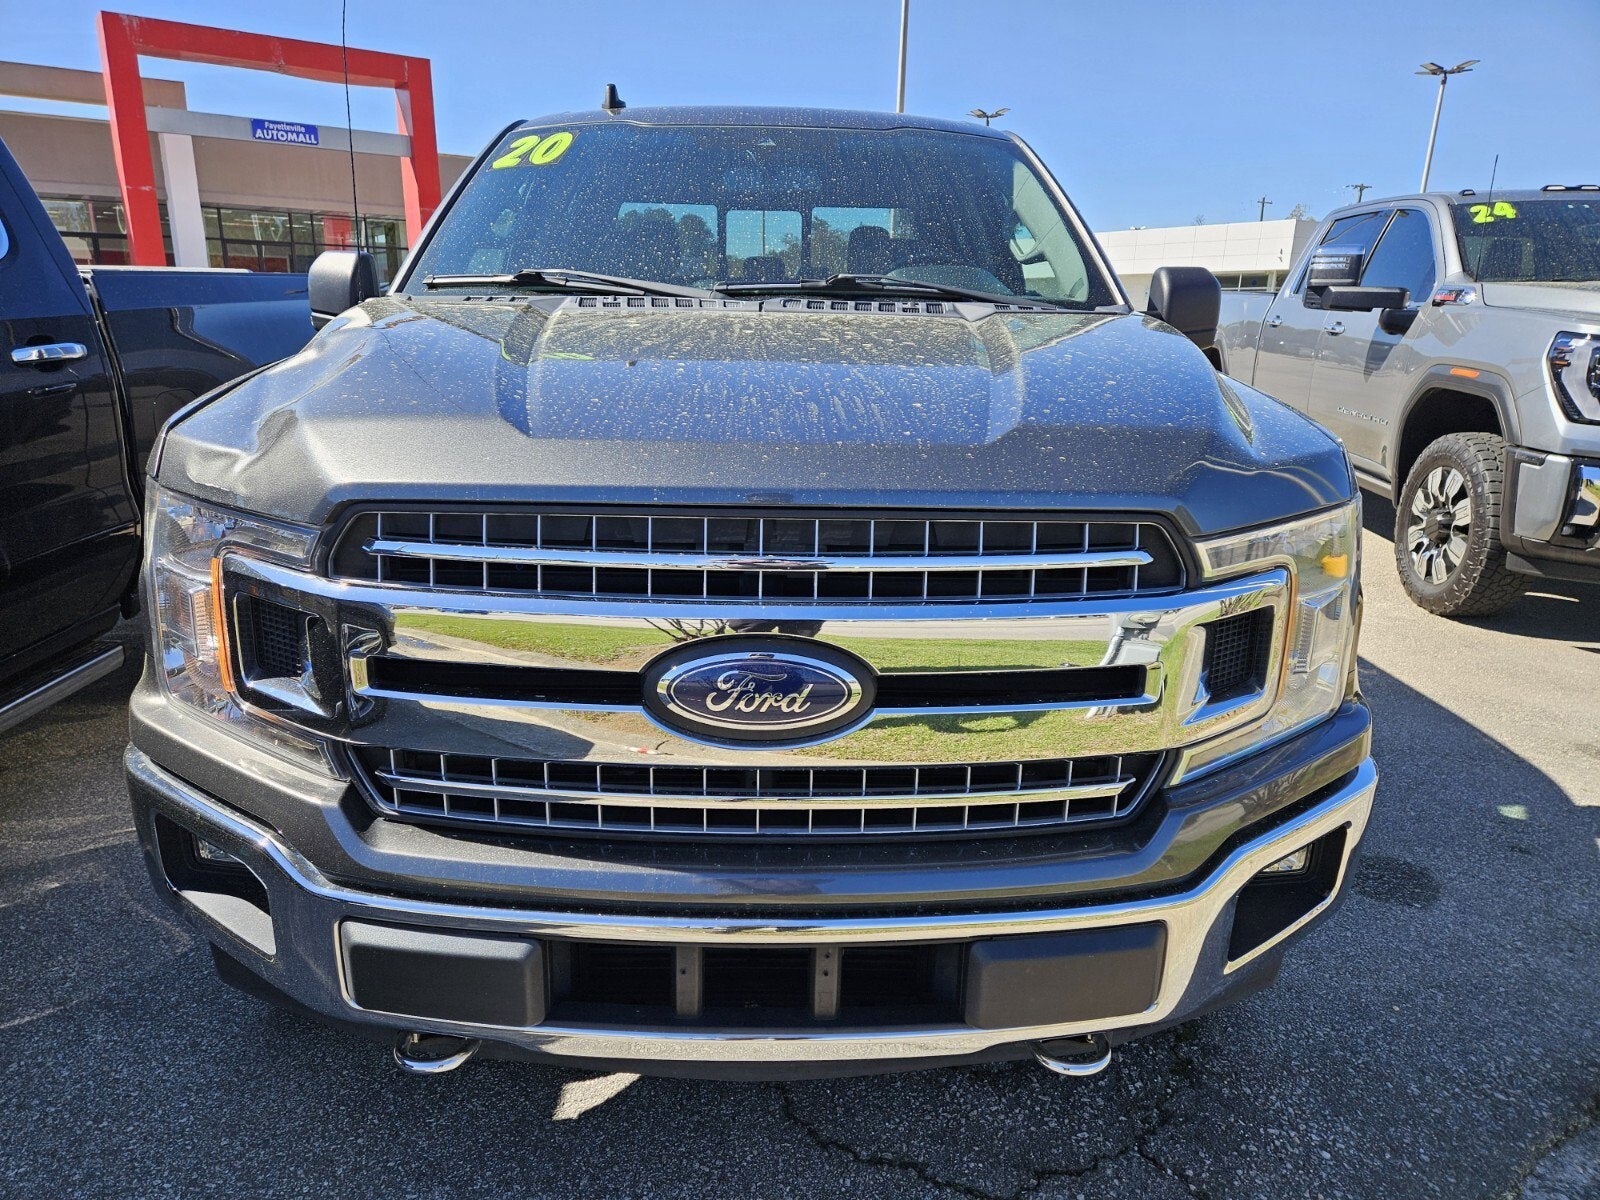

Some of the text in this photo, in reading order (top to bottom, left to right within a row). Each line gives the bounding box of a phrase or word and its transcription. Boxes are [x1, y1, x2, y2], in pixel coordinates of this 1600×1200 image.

[255, 128, 317, 144] AUTOMALL
[264, 121, 305, 133] Fayetteville
[492, 132, 573, 169] 20
[1470, 202, 1516, 223] 24
[706, 670, 814, 713] Ford
